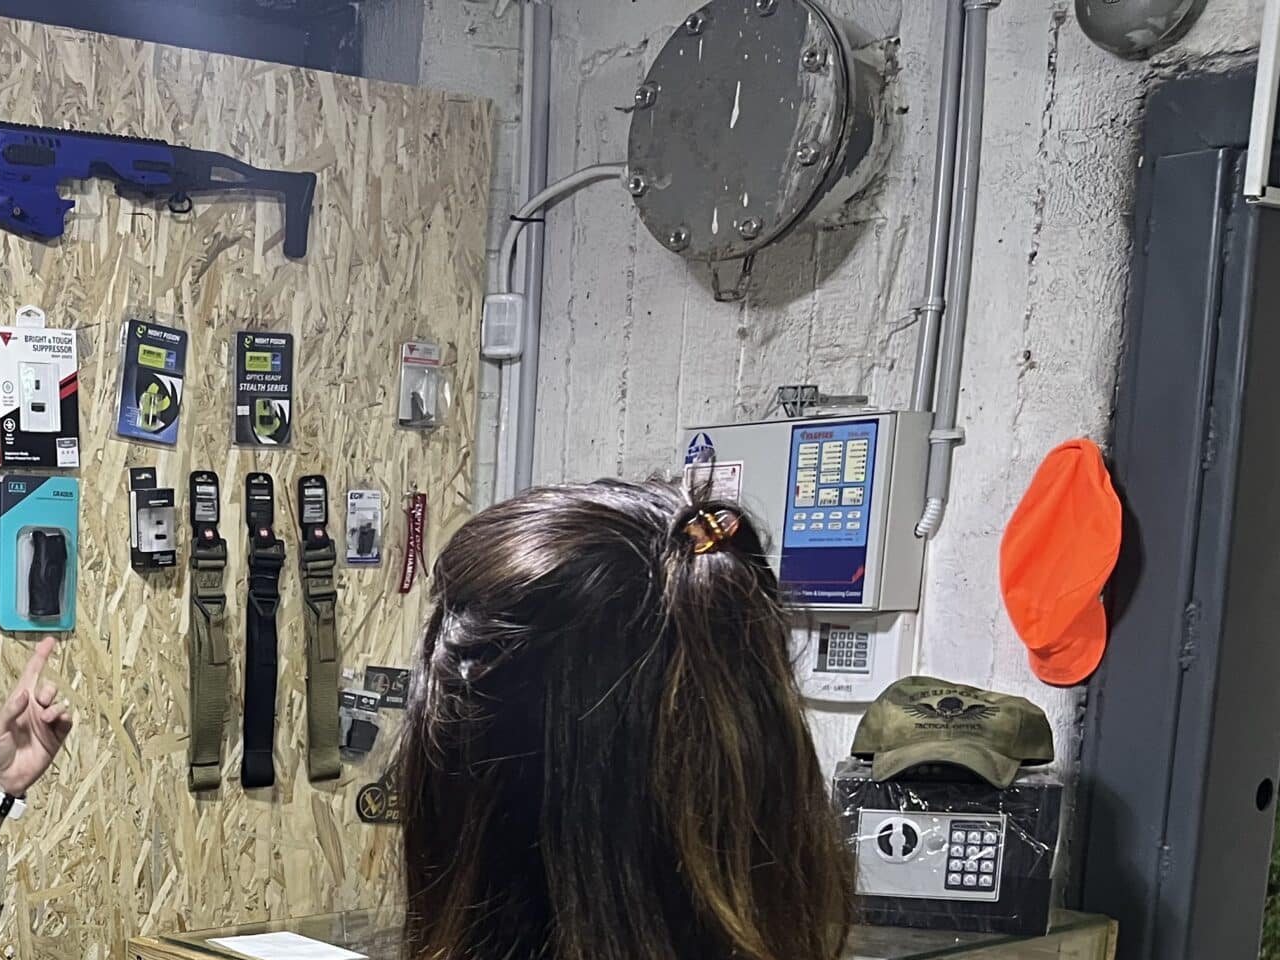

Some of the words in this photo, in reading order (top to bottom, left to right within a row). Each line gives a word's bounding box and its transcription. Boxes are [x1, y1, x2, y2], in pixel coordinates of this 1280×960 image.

[24, 335, 47, 343] BRIGHT
[52, 336, 73, 345] TOUGH
[32, 344, 73, 353] SUPPRESSOR
[239, 383, 266, 391] STEALTH
[266, 383, 288, 392] SERIES
